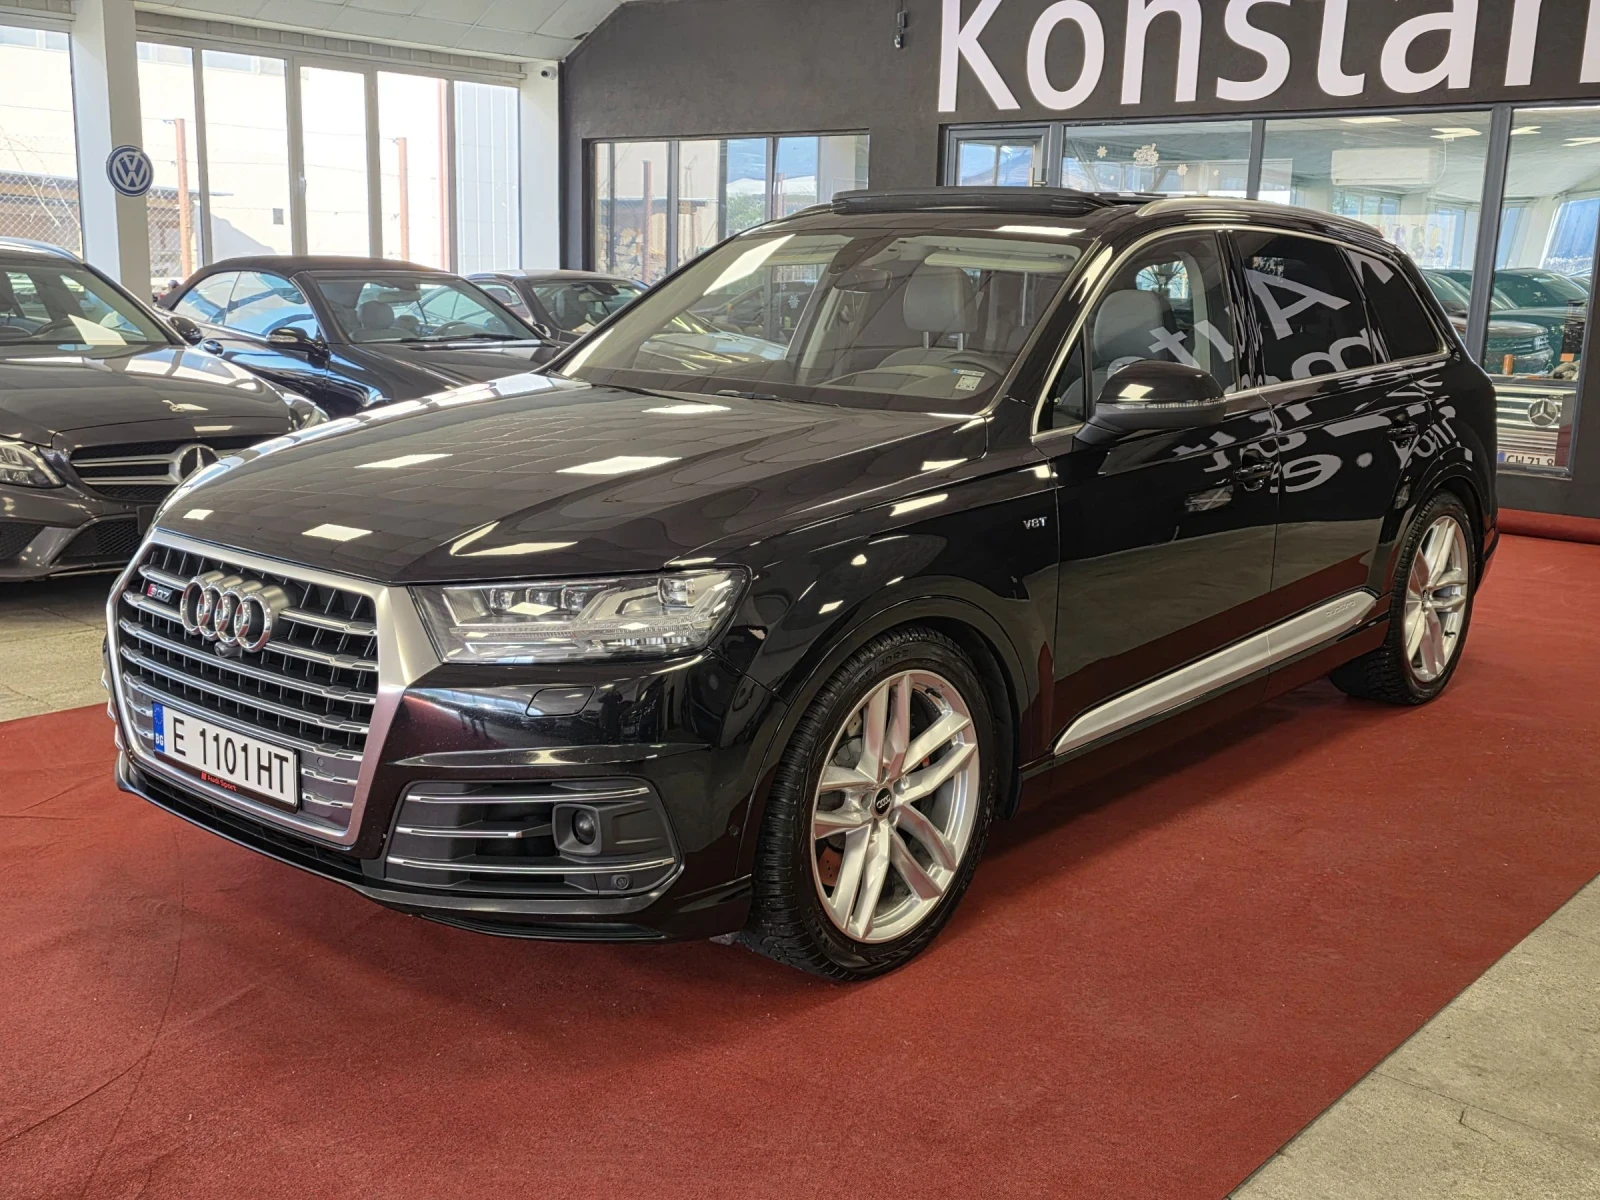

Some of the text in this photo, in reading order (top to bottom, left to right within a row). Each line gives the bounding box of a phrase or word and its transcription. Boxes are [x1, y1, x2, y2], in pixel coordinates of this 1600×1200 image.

[155, 732, 164, 746] BG
[173, 716, 186, 757] E
[207, 774, 237, 792] Audi Sport
